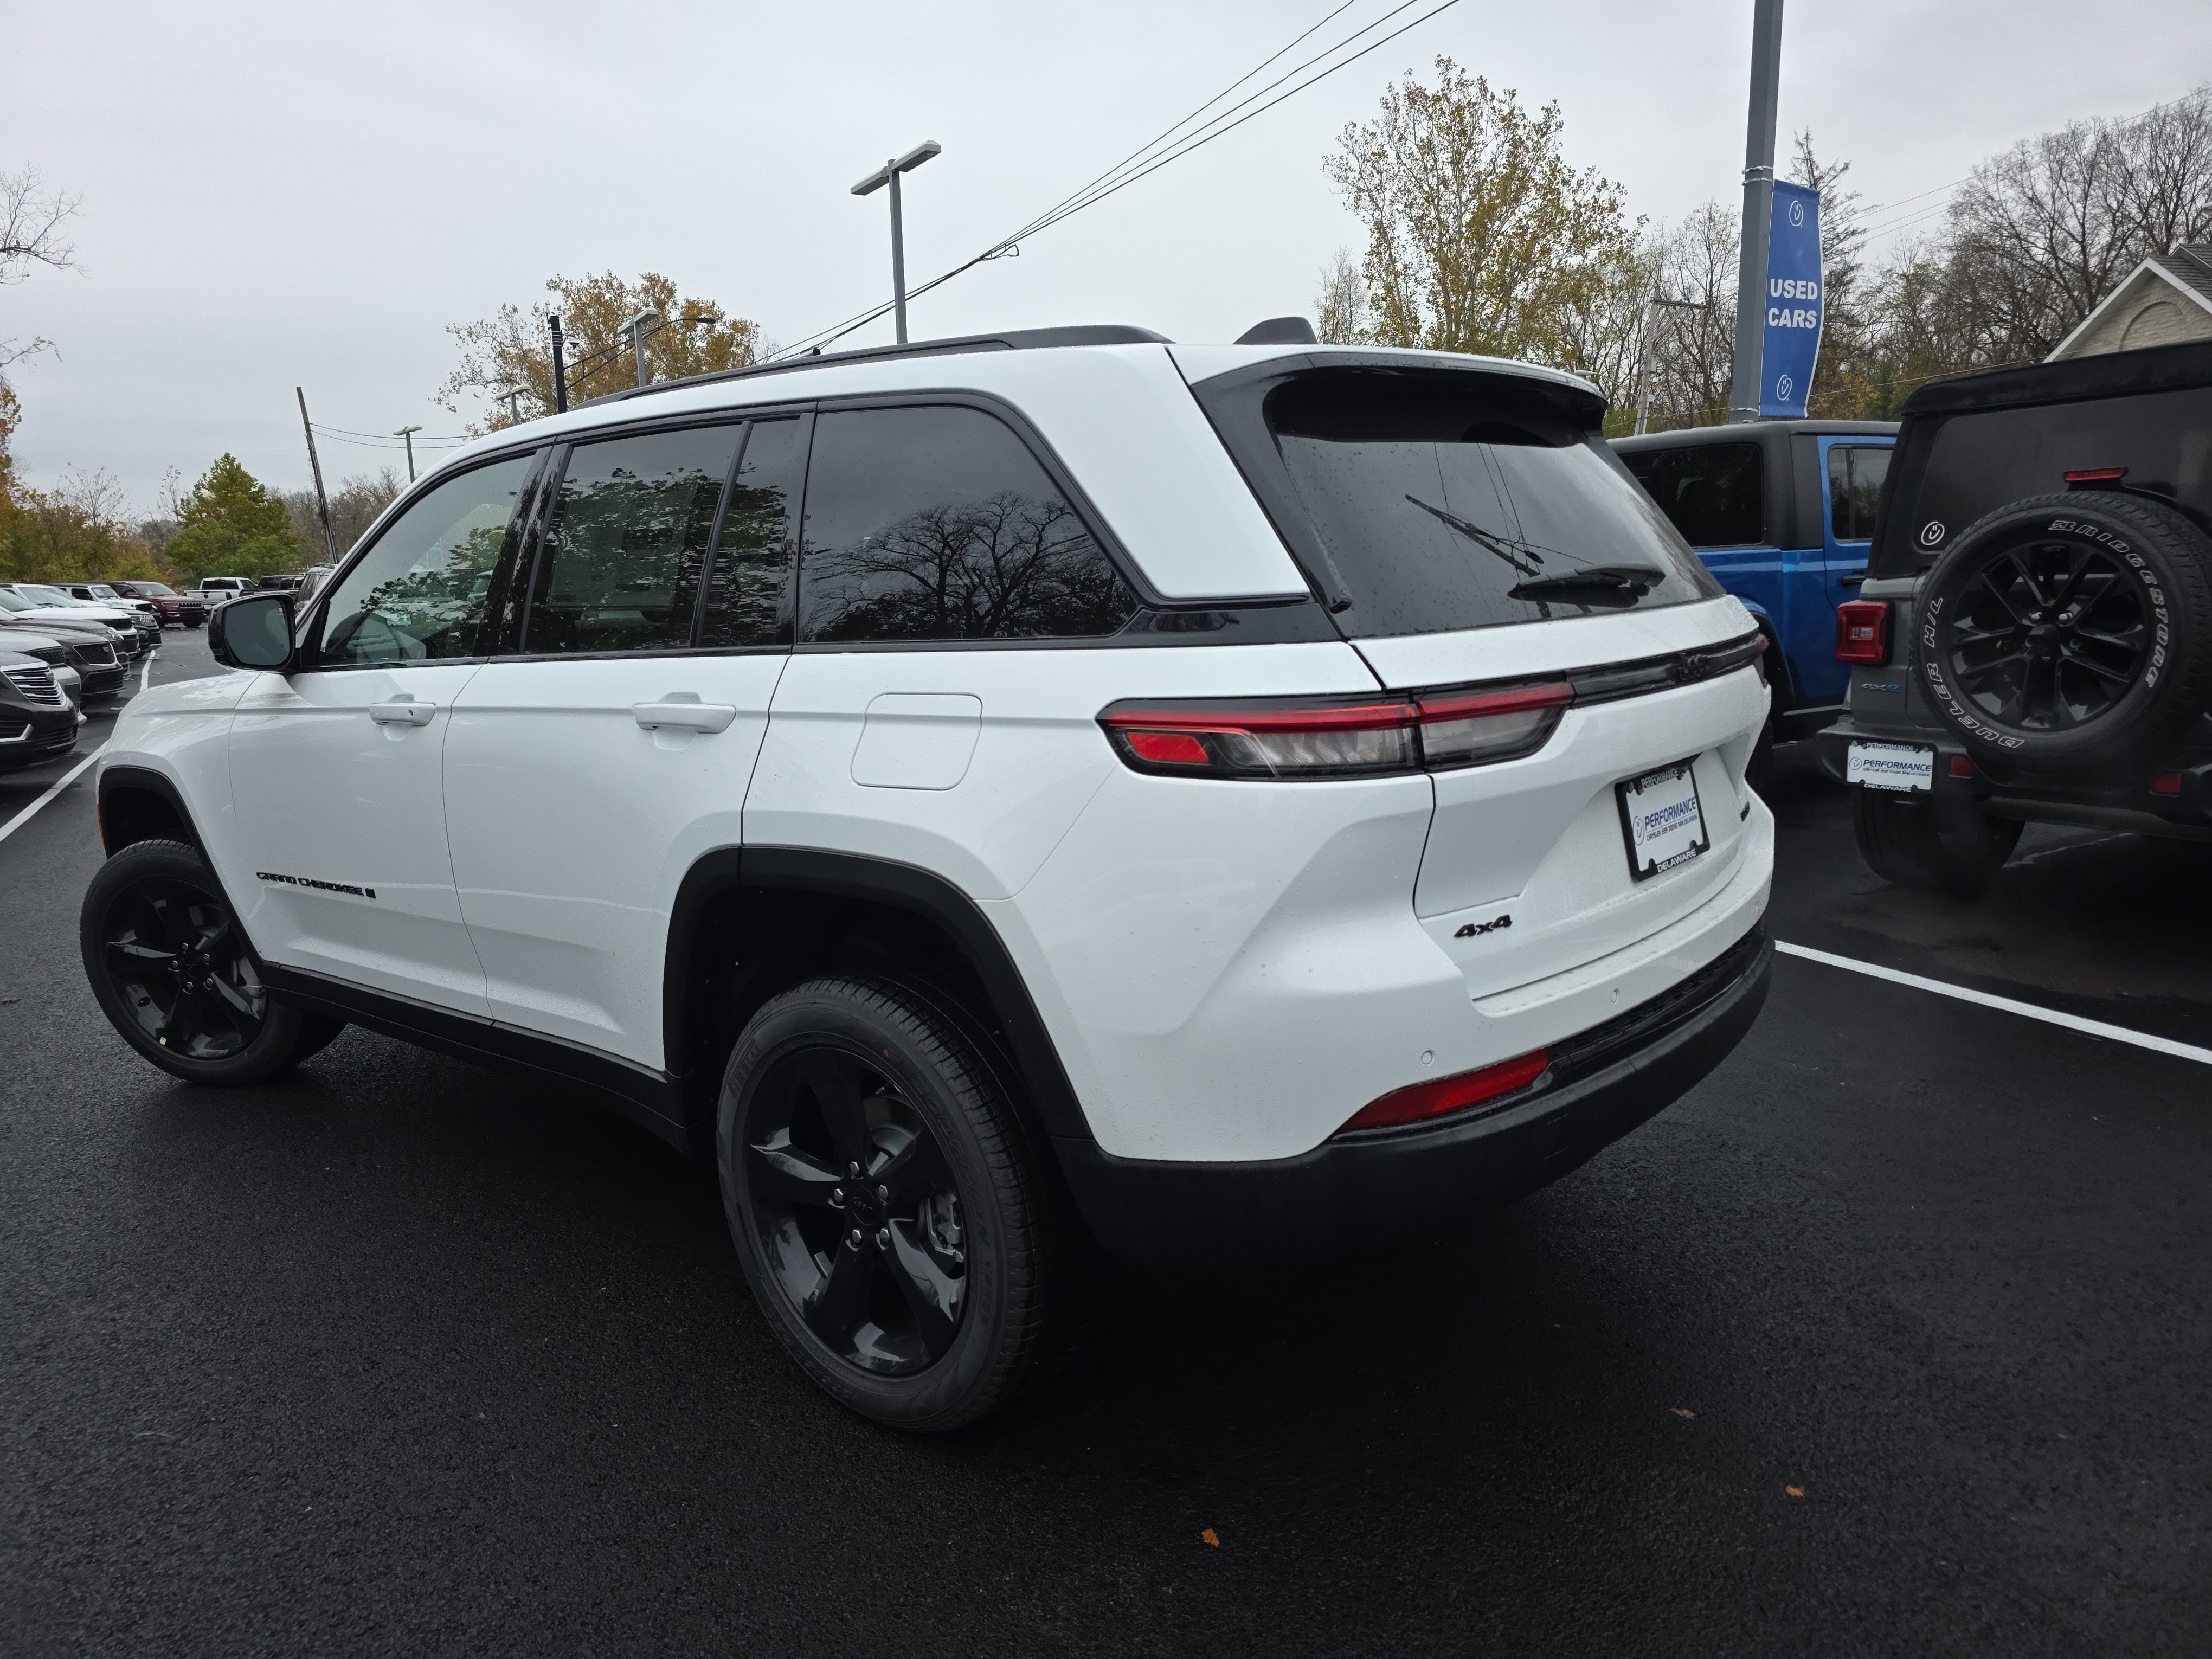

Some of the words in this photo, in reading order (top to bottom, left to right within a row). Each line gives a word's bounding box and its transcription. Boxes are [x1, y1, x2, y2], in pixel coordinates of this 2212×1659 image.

[1770, 278, 1818, 300] USED
[1768, 307, 1817, 329] CARS
[2048, 519, 2169, 689] BRIDGESTONE
[1926, 662, 2025, 749] DUELER
[1867, 743, 1913, 751] PERFORMANCE
[1863, 759, 1932, 772] PERFORMANCE
[1642, 769, 1679, 788] PERFORMANCE
[1864, 784, 1911, 792] DELAWARE
[1645, 797, 1696, 830] PERFORMANCE
[1646, 829, 1661, 841] CHRYSLER
[1668, 822, 1678, 833] DODGE
[1684, 814, 1698, 826] DELAWARE
[1657, 849, 1696, 872] DELAWARE
[256, 872, 297, 884] GRAND
[298, 877, 364, 896] CHEROKEE
